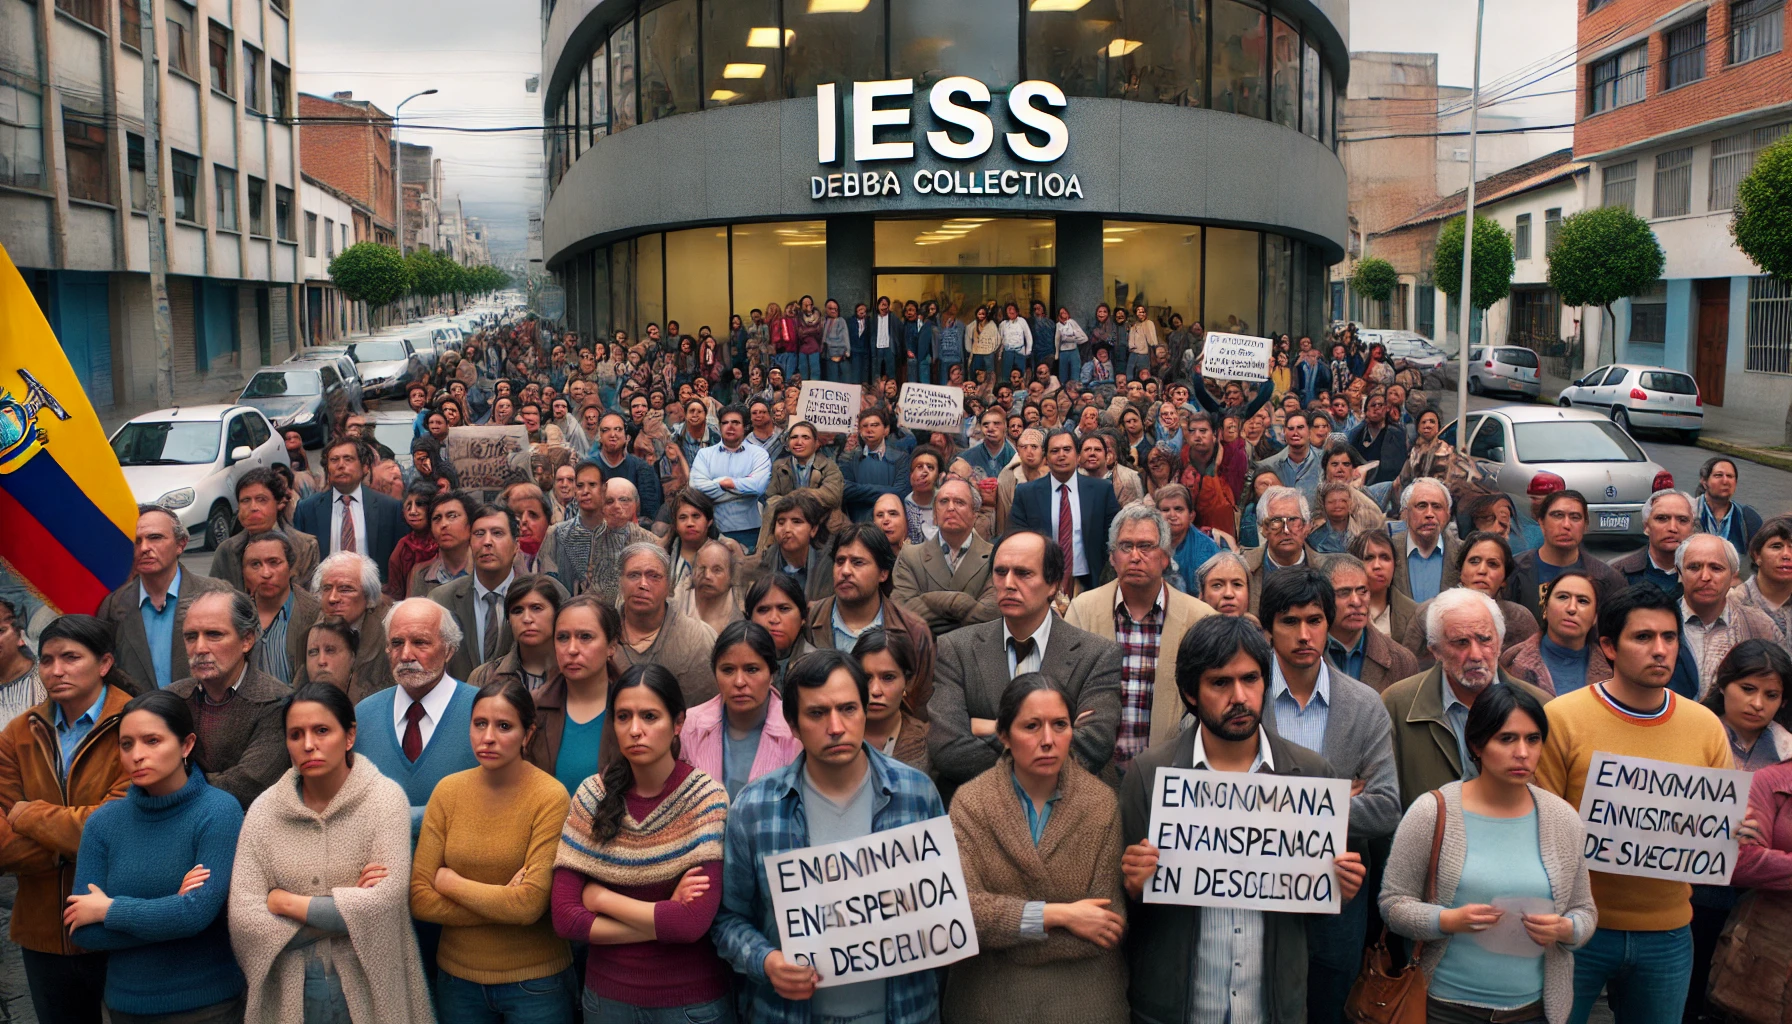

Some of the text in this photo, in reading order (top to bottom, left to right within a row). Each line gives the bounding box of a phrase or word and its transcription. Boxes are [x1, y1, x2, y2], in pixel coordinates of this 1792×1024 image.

[816, 76, 1069, 163] IESS
[913, 169, 1084, 199] COLLECTIOA
[1584, 833, 1614, 863] DE
[1152, 865, 1182, 894] EN
